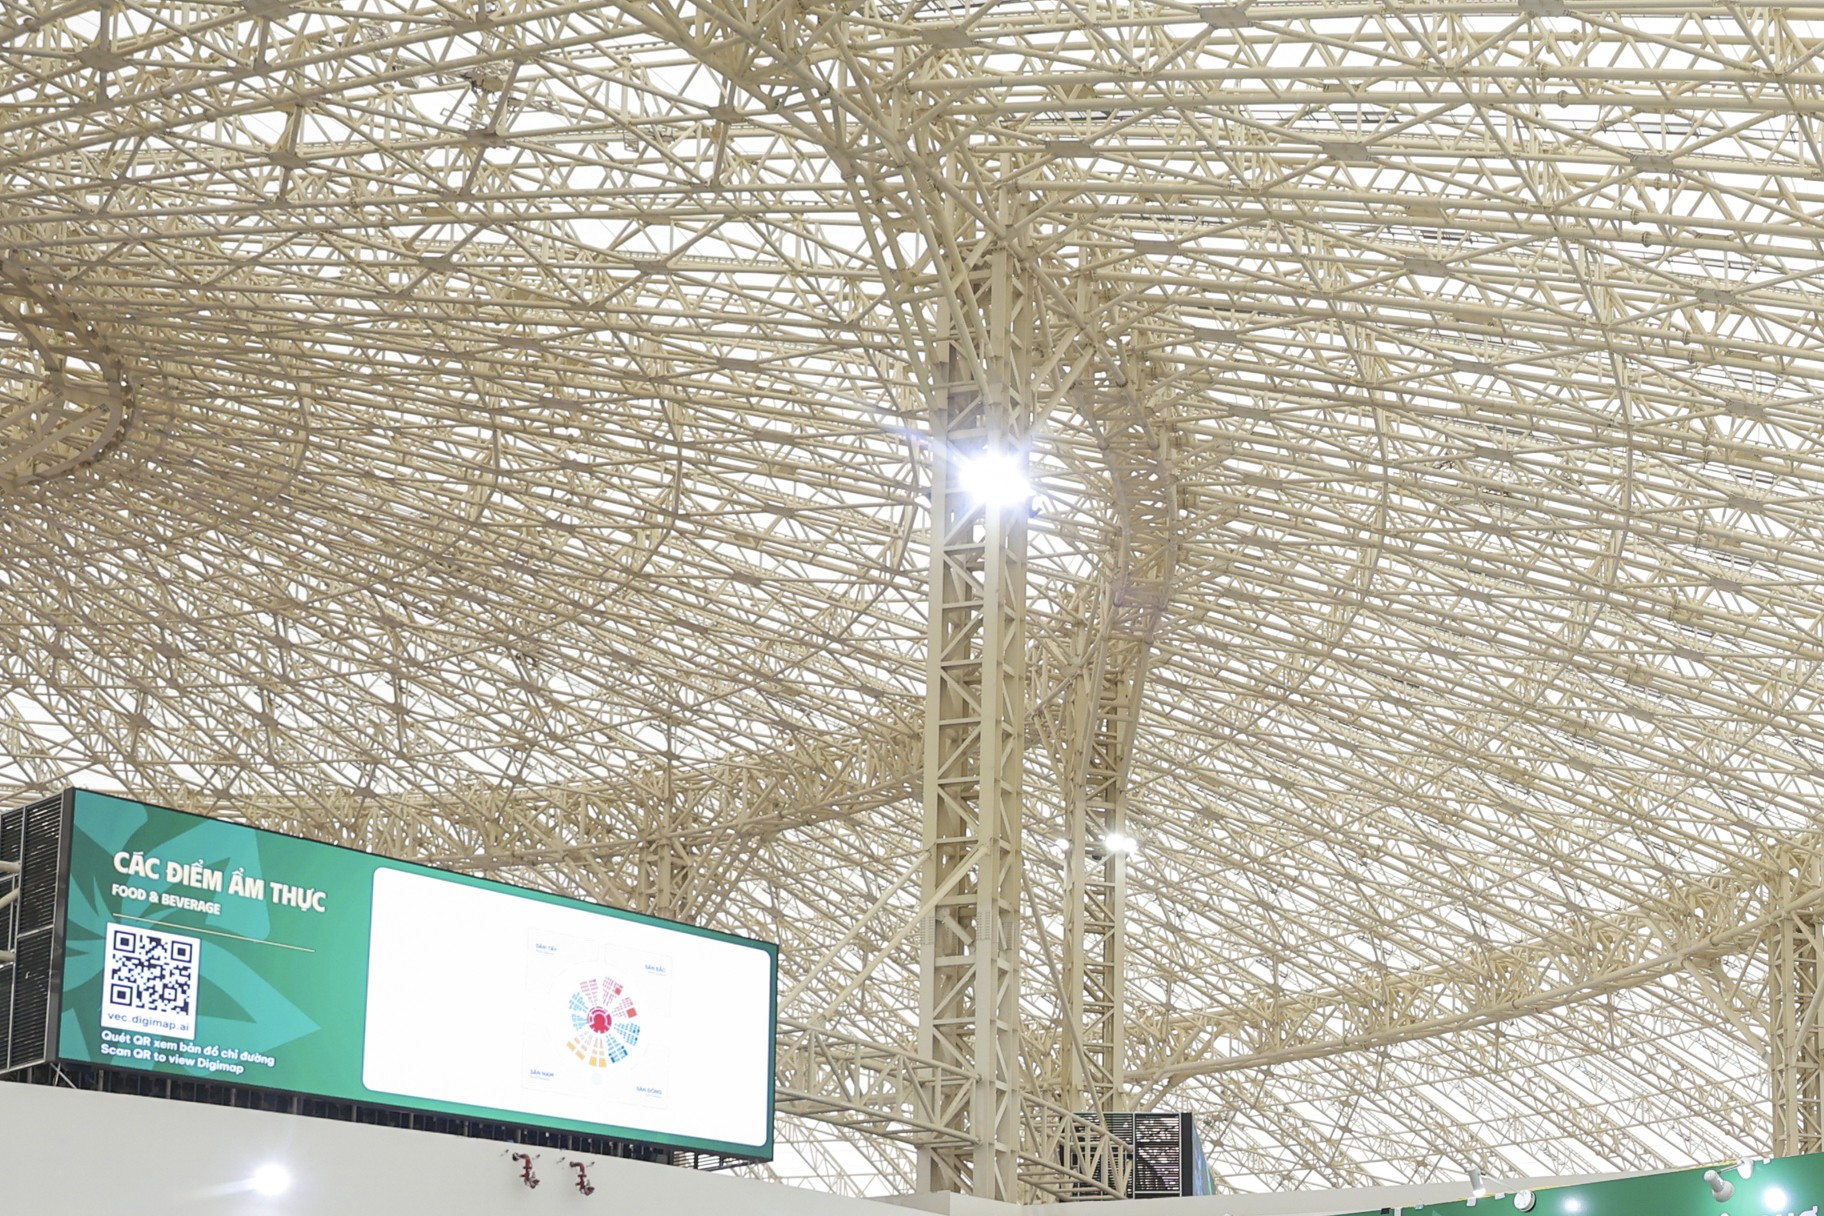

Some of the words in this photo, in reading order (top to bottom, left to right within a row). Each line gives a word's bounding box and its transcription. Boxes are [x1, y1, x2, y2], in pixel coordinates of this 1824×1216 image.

[113, 851, 161, 880] CÁC
[166, 859, 223, 892] ĐIỂM
[228, 867, 264, 900] ẨM
[270, 881, 327, 913] THỰC
[112, 883, 146, 901] FOOD
[149, 891, 159, 903] &
[161, 893, 221, 915] BEVERAGE
[107, 1011, 190, 1032] vec.digimap.ai
[101, 1030, 131, 1046] Quét
[133, 1035, 151, 1047] QR
[153, 1039, 177, 1051] xem
[179, 1041, 201, 1055] bản
[221, 1047, 239, 1060] chỉ
[240, 1051, 275, 1067] đường
[101, 1044, 131, 1058] Scan
[133, 1048, 151, 1060] QR
[153, 1050, 167, 1063] to
[168, 1053, 196, 1067] view
[197, 1058, 245, 1075] Digimap
